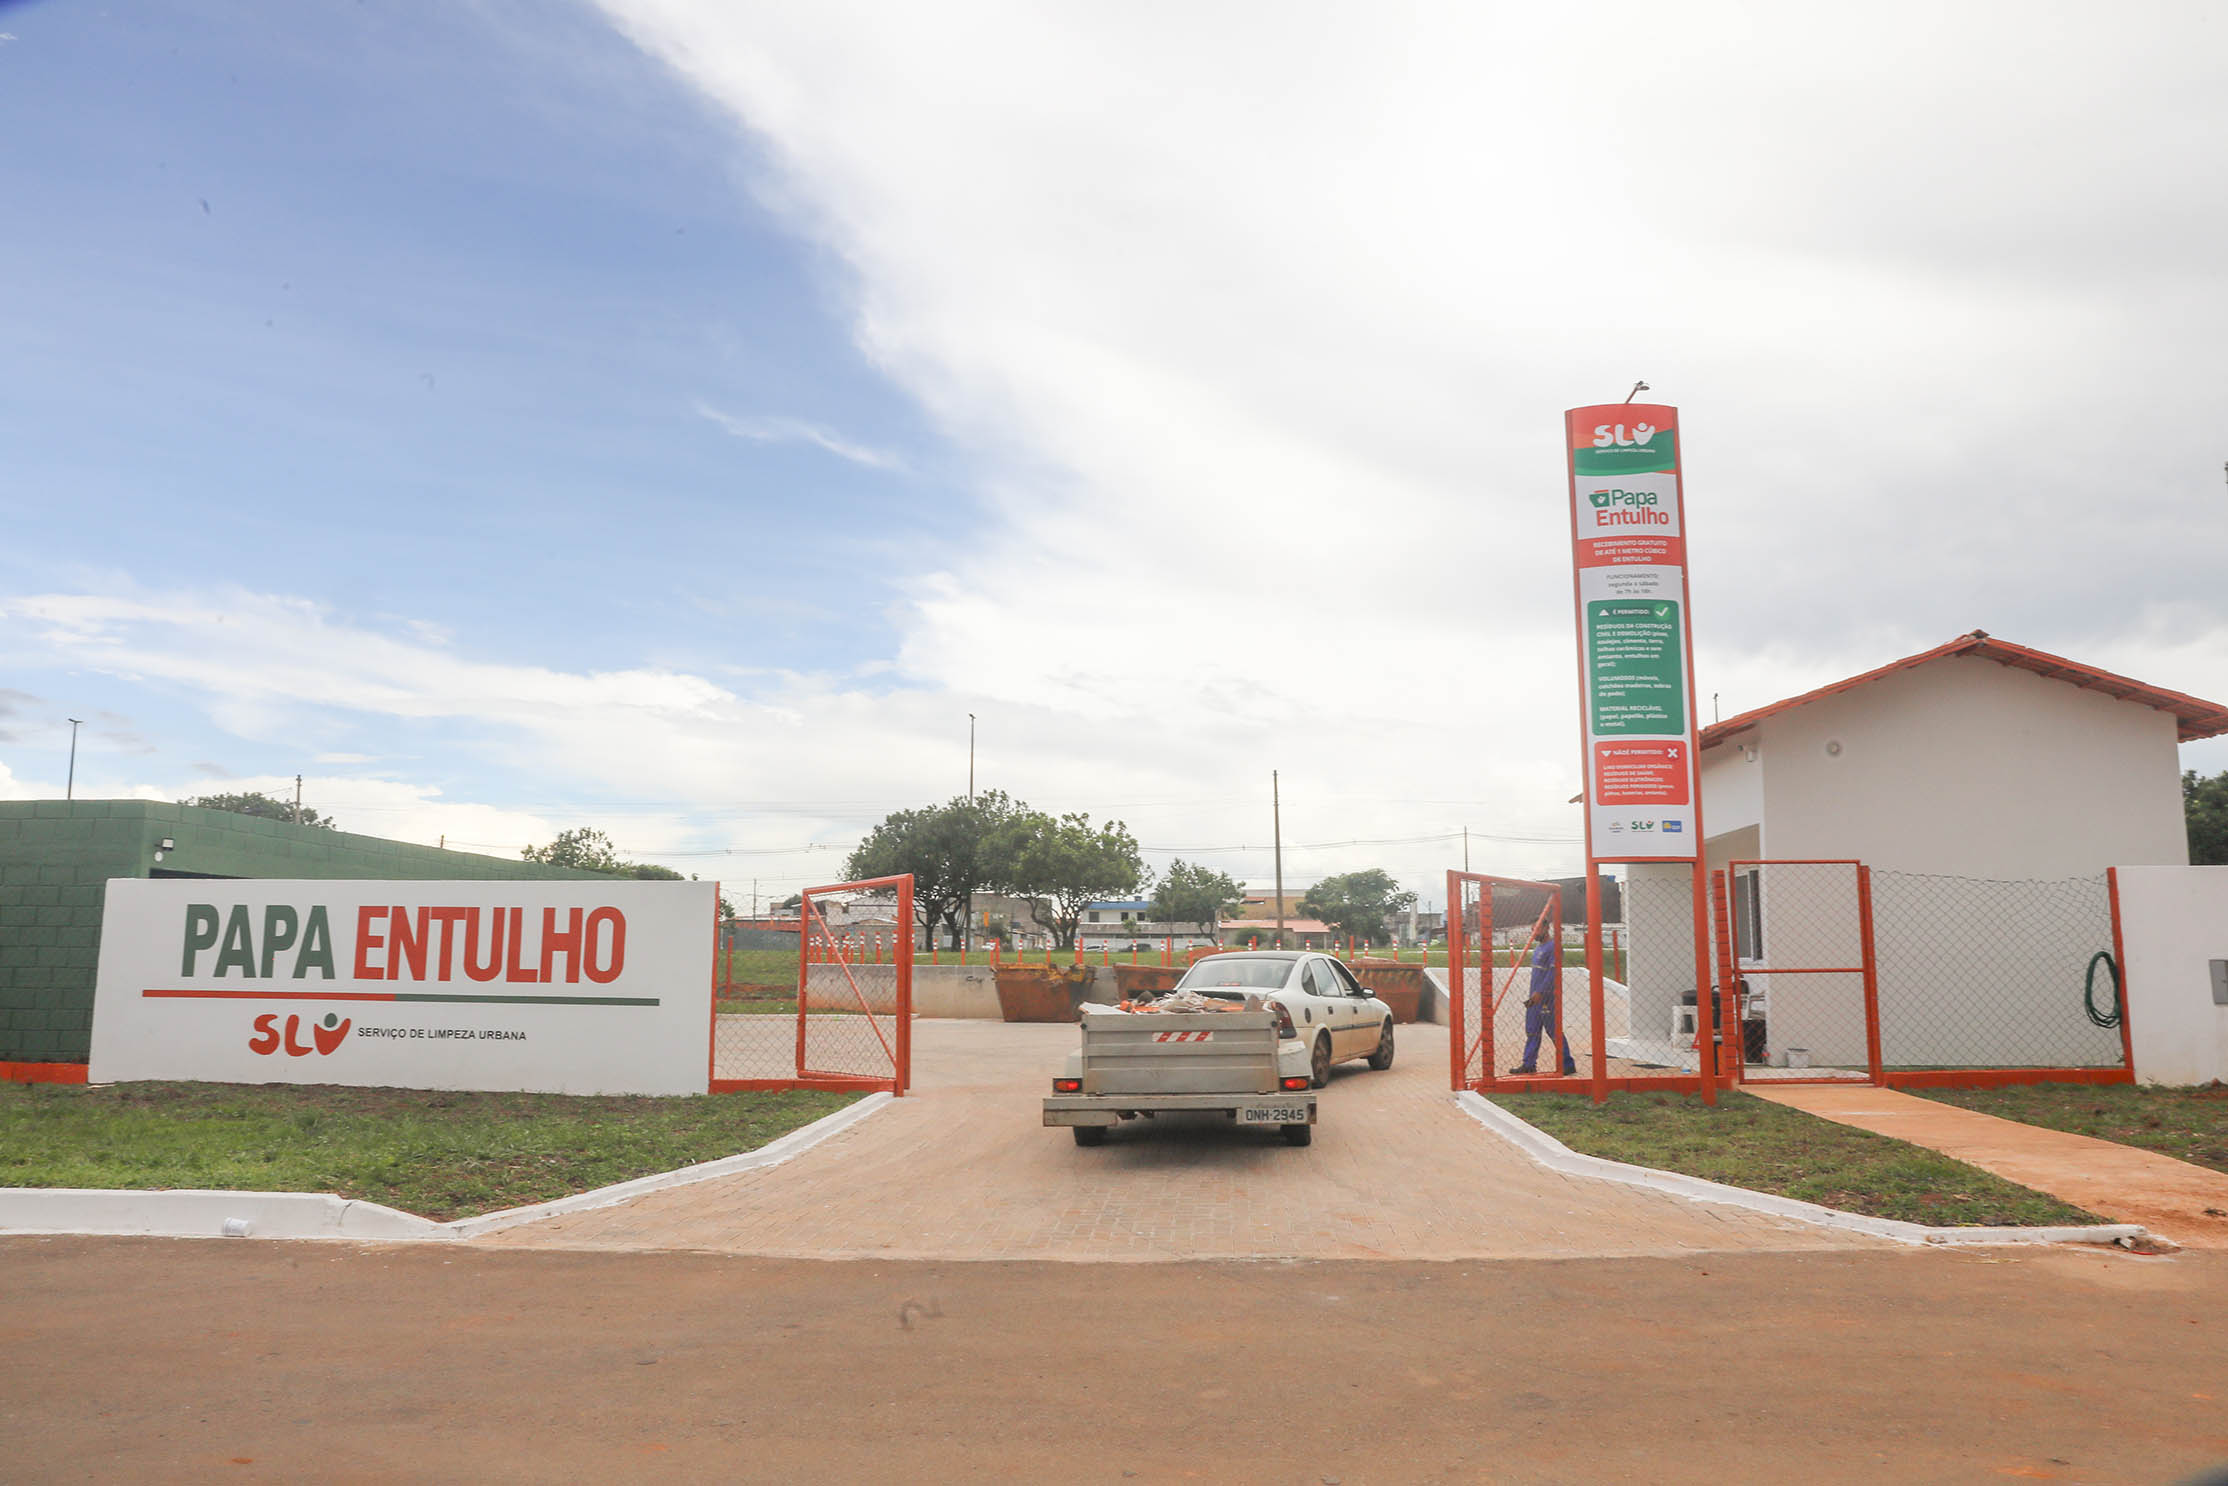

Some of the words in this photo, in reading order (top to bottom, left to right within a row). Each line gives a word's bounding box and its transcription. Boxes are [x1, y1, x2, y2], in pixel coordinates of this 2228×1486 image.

[1611, 489, 1658, 509] Papa
[1596, 507, 1670, 527] Entulho
[181, 904, 335, 980] PAPA
[353, 905, 627, 984] ENTULHO
[248, 1012, 352, 1057] SLU
[357, 1027, 407, 1041] SERVIÇO
[409, 1028, 425, 1039] DE
[428, 1028, 476, 1041] LIMPEZA
[478, 1030, 527, 1041] URBANA
